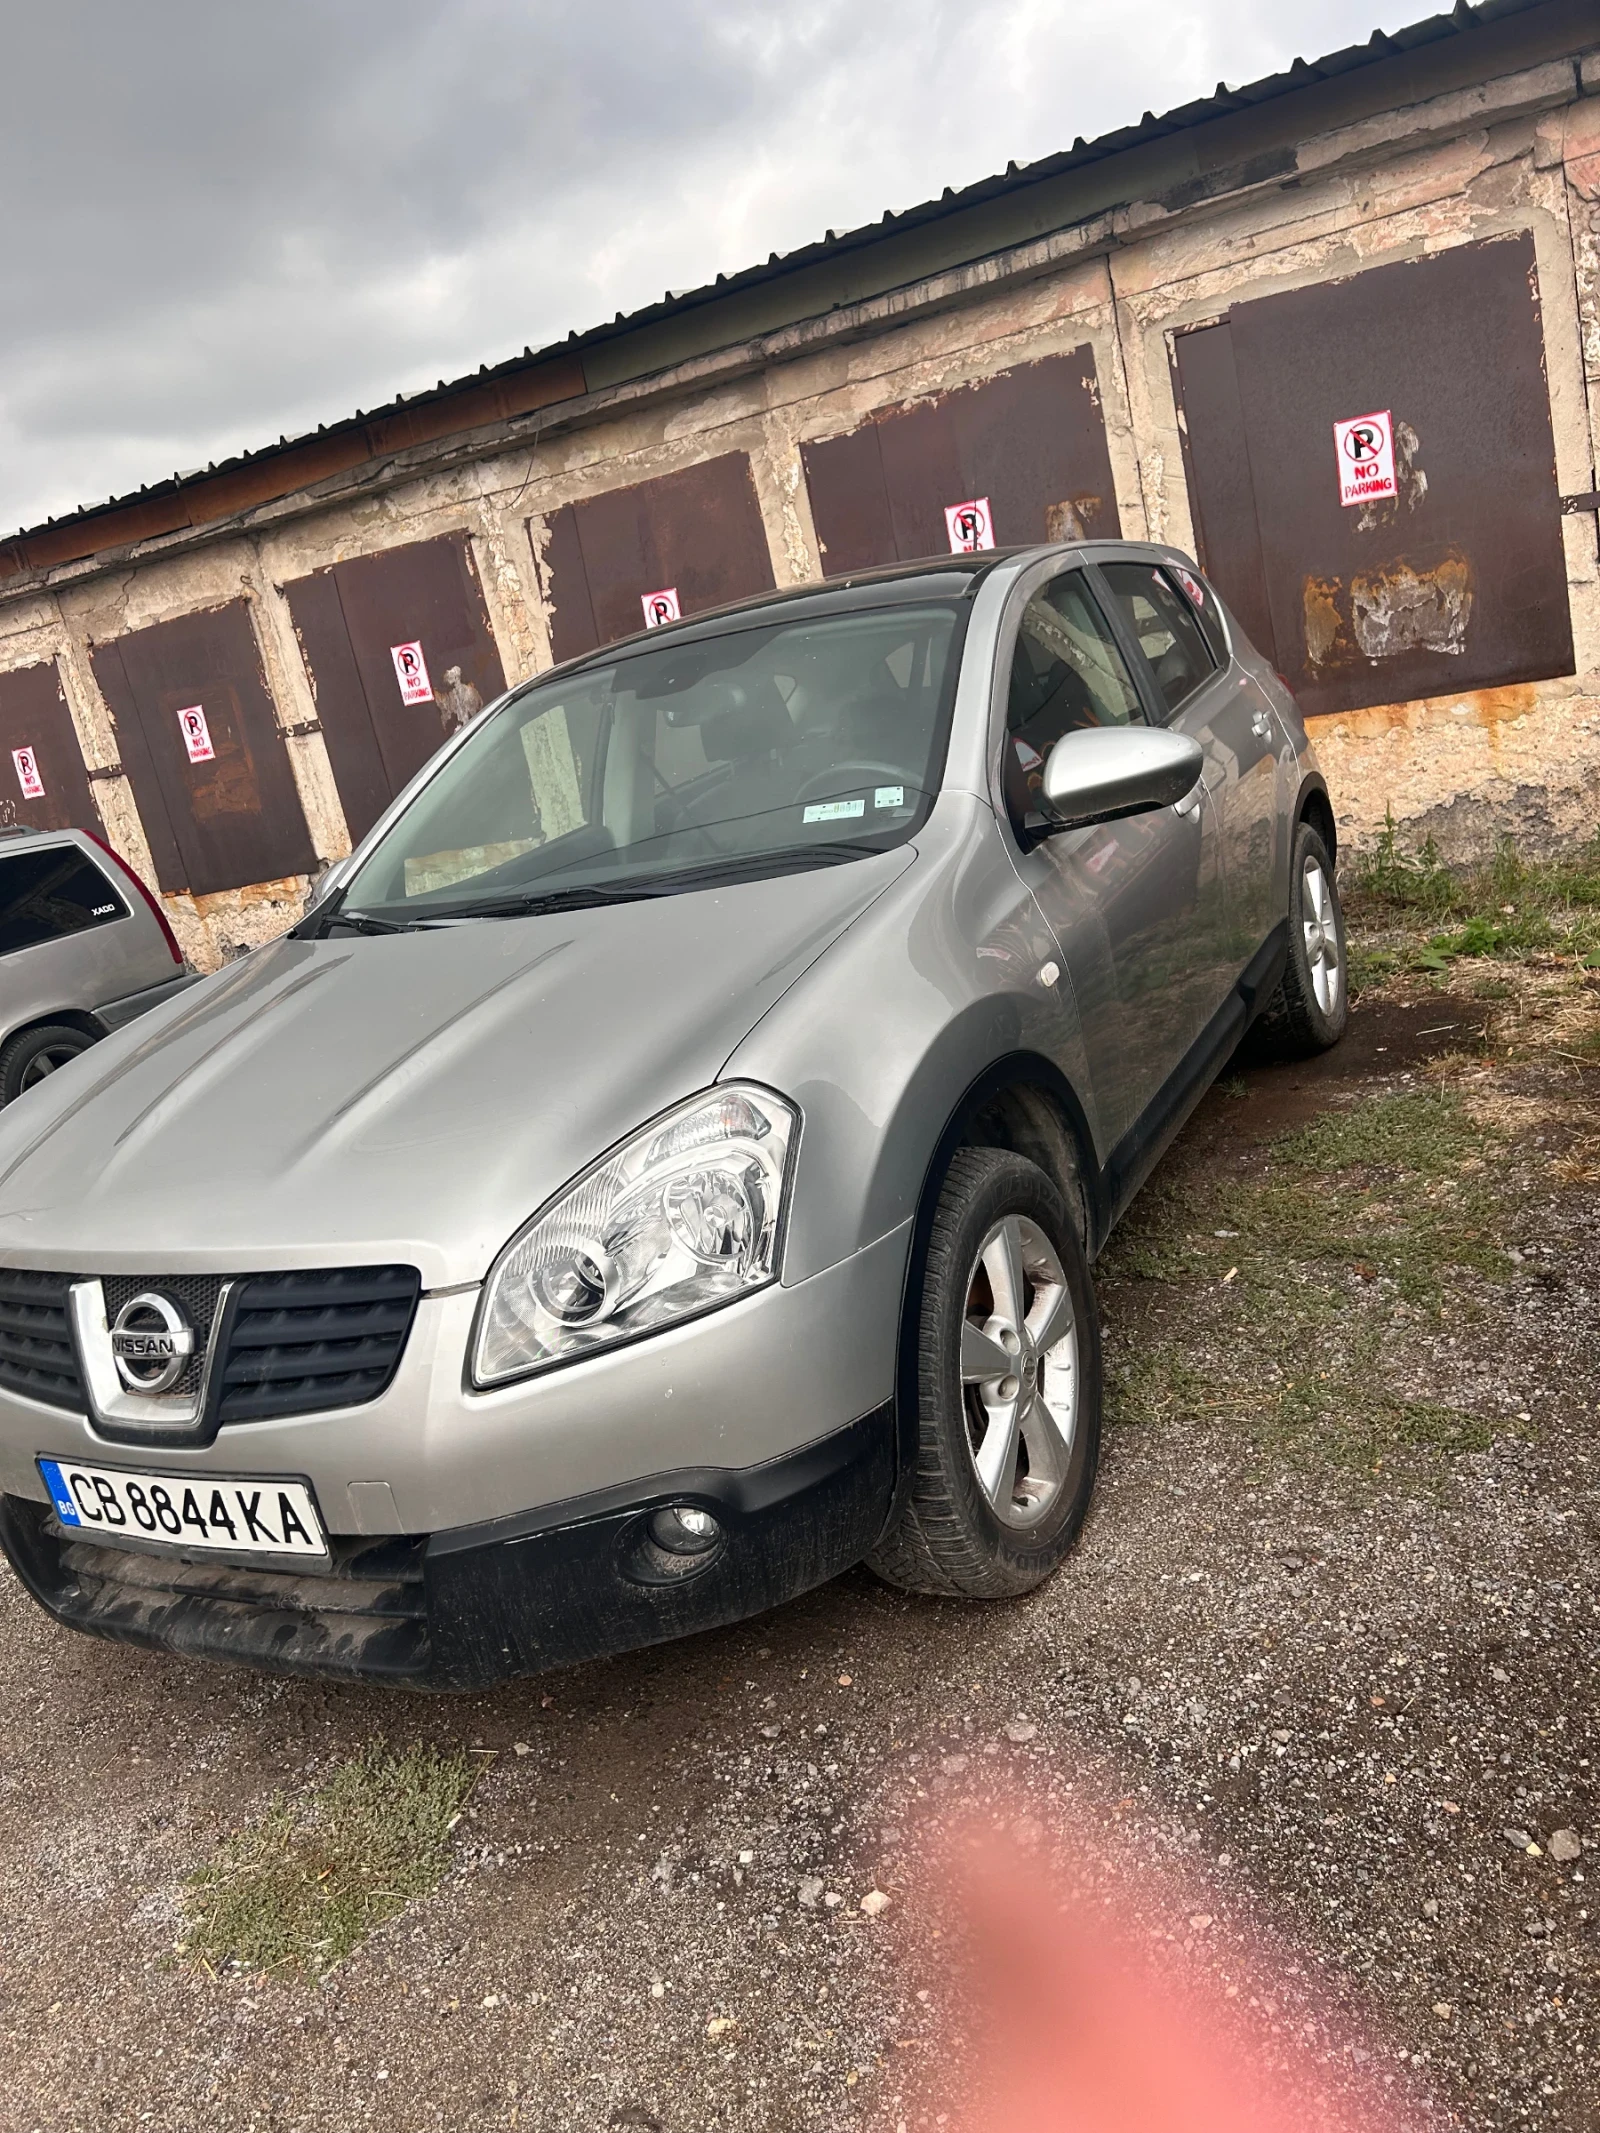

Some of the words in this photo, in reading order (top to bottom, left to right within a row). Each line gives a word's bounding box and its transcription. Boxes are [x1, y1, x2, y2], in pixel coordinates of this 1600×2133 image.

[1354, 463, 1379, 480] NO
[1344, 478, 1392, 498] PARKING
[406, 677, 421, 688] NO
[403, 687, 430, 701] PARKING
[192, 737, 205, 747] NO
[24, 775, 36, 785] NO
[91, 903, 116, 916] XADO
[112, 1337, 174, 1353] NISSAN
[57, 1500, 76, 1516] BG
